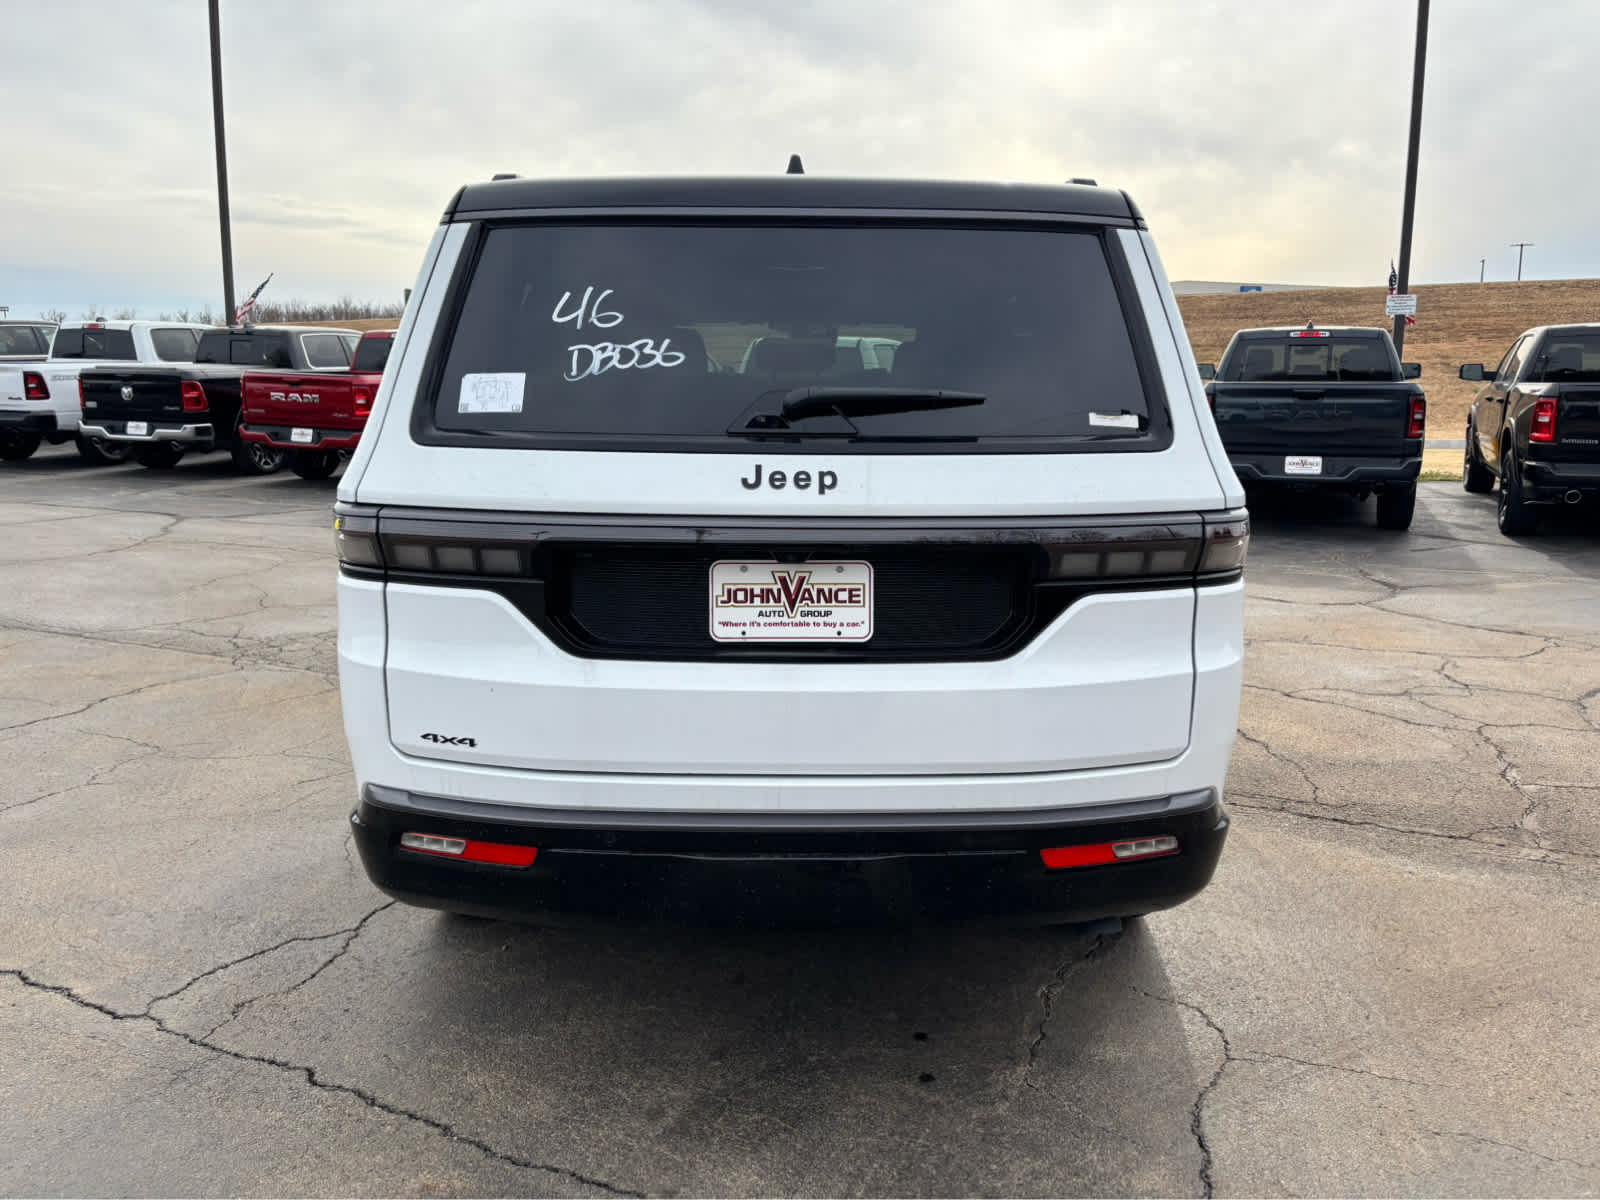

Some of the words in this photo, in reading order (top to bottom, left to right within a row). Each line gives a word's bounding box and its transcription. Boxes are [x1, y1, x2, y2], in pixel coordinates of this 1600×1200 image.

[552, 286, 624, 330] 46
[270, 391, 320, 404] RAM
[741, 463, 838, 495] Jeep
[757, 610, 785, 618] AUTO
[800, 610, 833, 618] GROUP
[420, 733, 477, 748] 4x4
